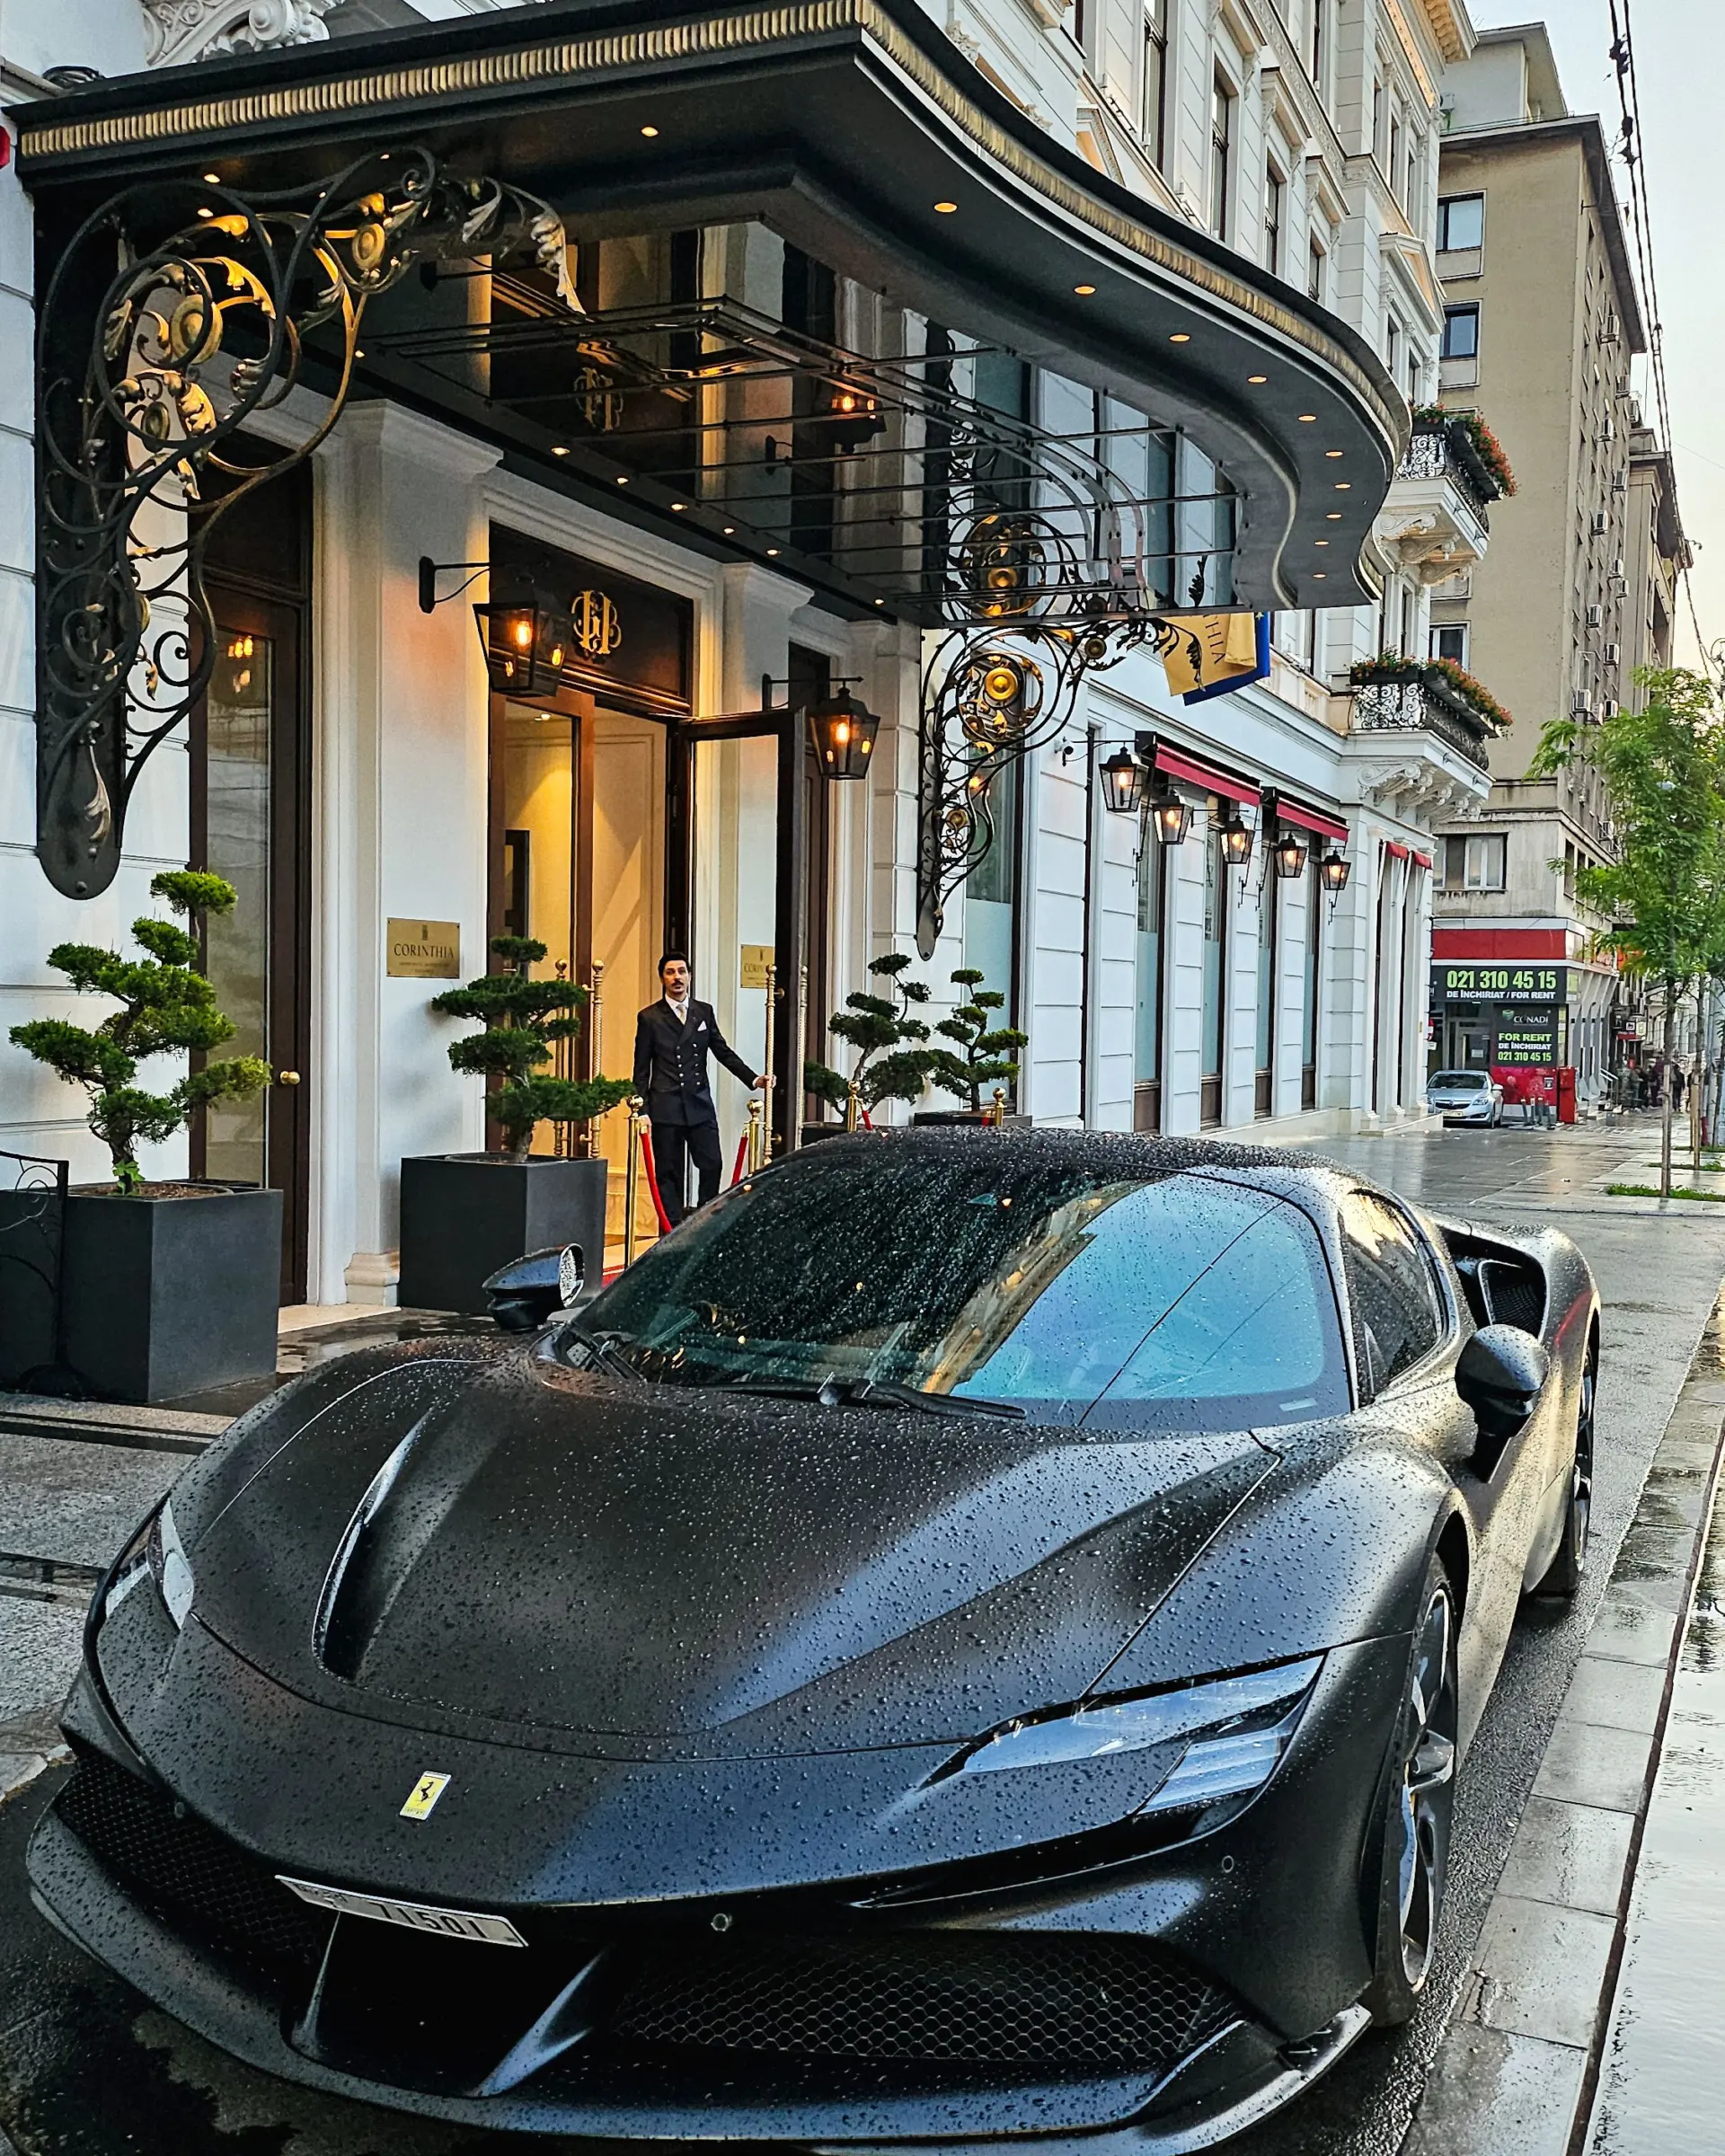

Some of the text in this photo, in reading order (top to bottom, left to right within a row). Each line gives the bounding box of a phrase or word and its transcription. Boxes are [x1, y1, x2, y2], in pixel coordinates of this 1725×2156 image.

[394, 943, 455, 959] CORINTHIA
[1446, 970, 1557, 989] 021 310 45 15
[1446, 990, 1459, 999] DE
[1511, 991, 1530, 999] FOR
[1531, 991, 1556, 1000] RENT
[1498, 1032, 1552, 1042] FOR RENT
[1498, 1051, 1552, 1062] 021 310 45 15
[367, 1900, 488, 1939] 71501
